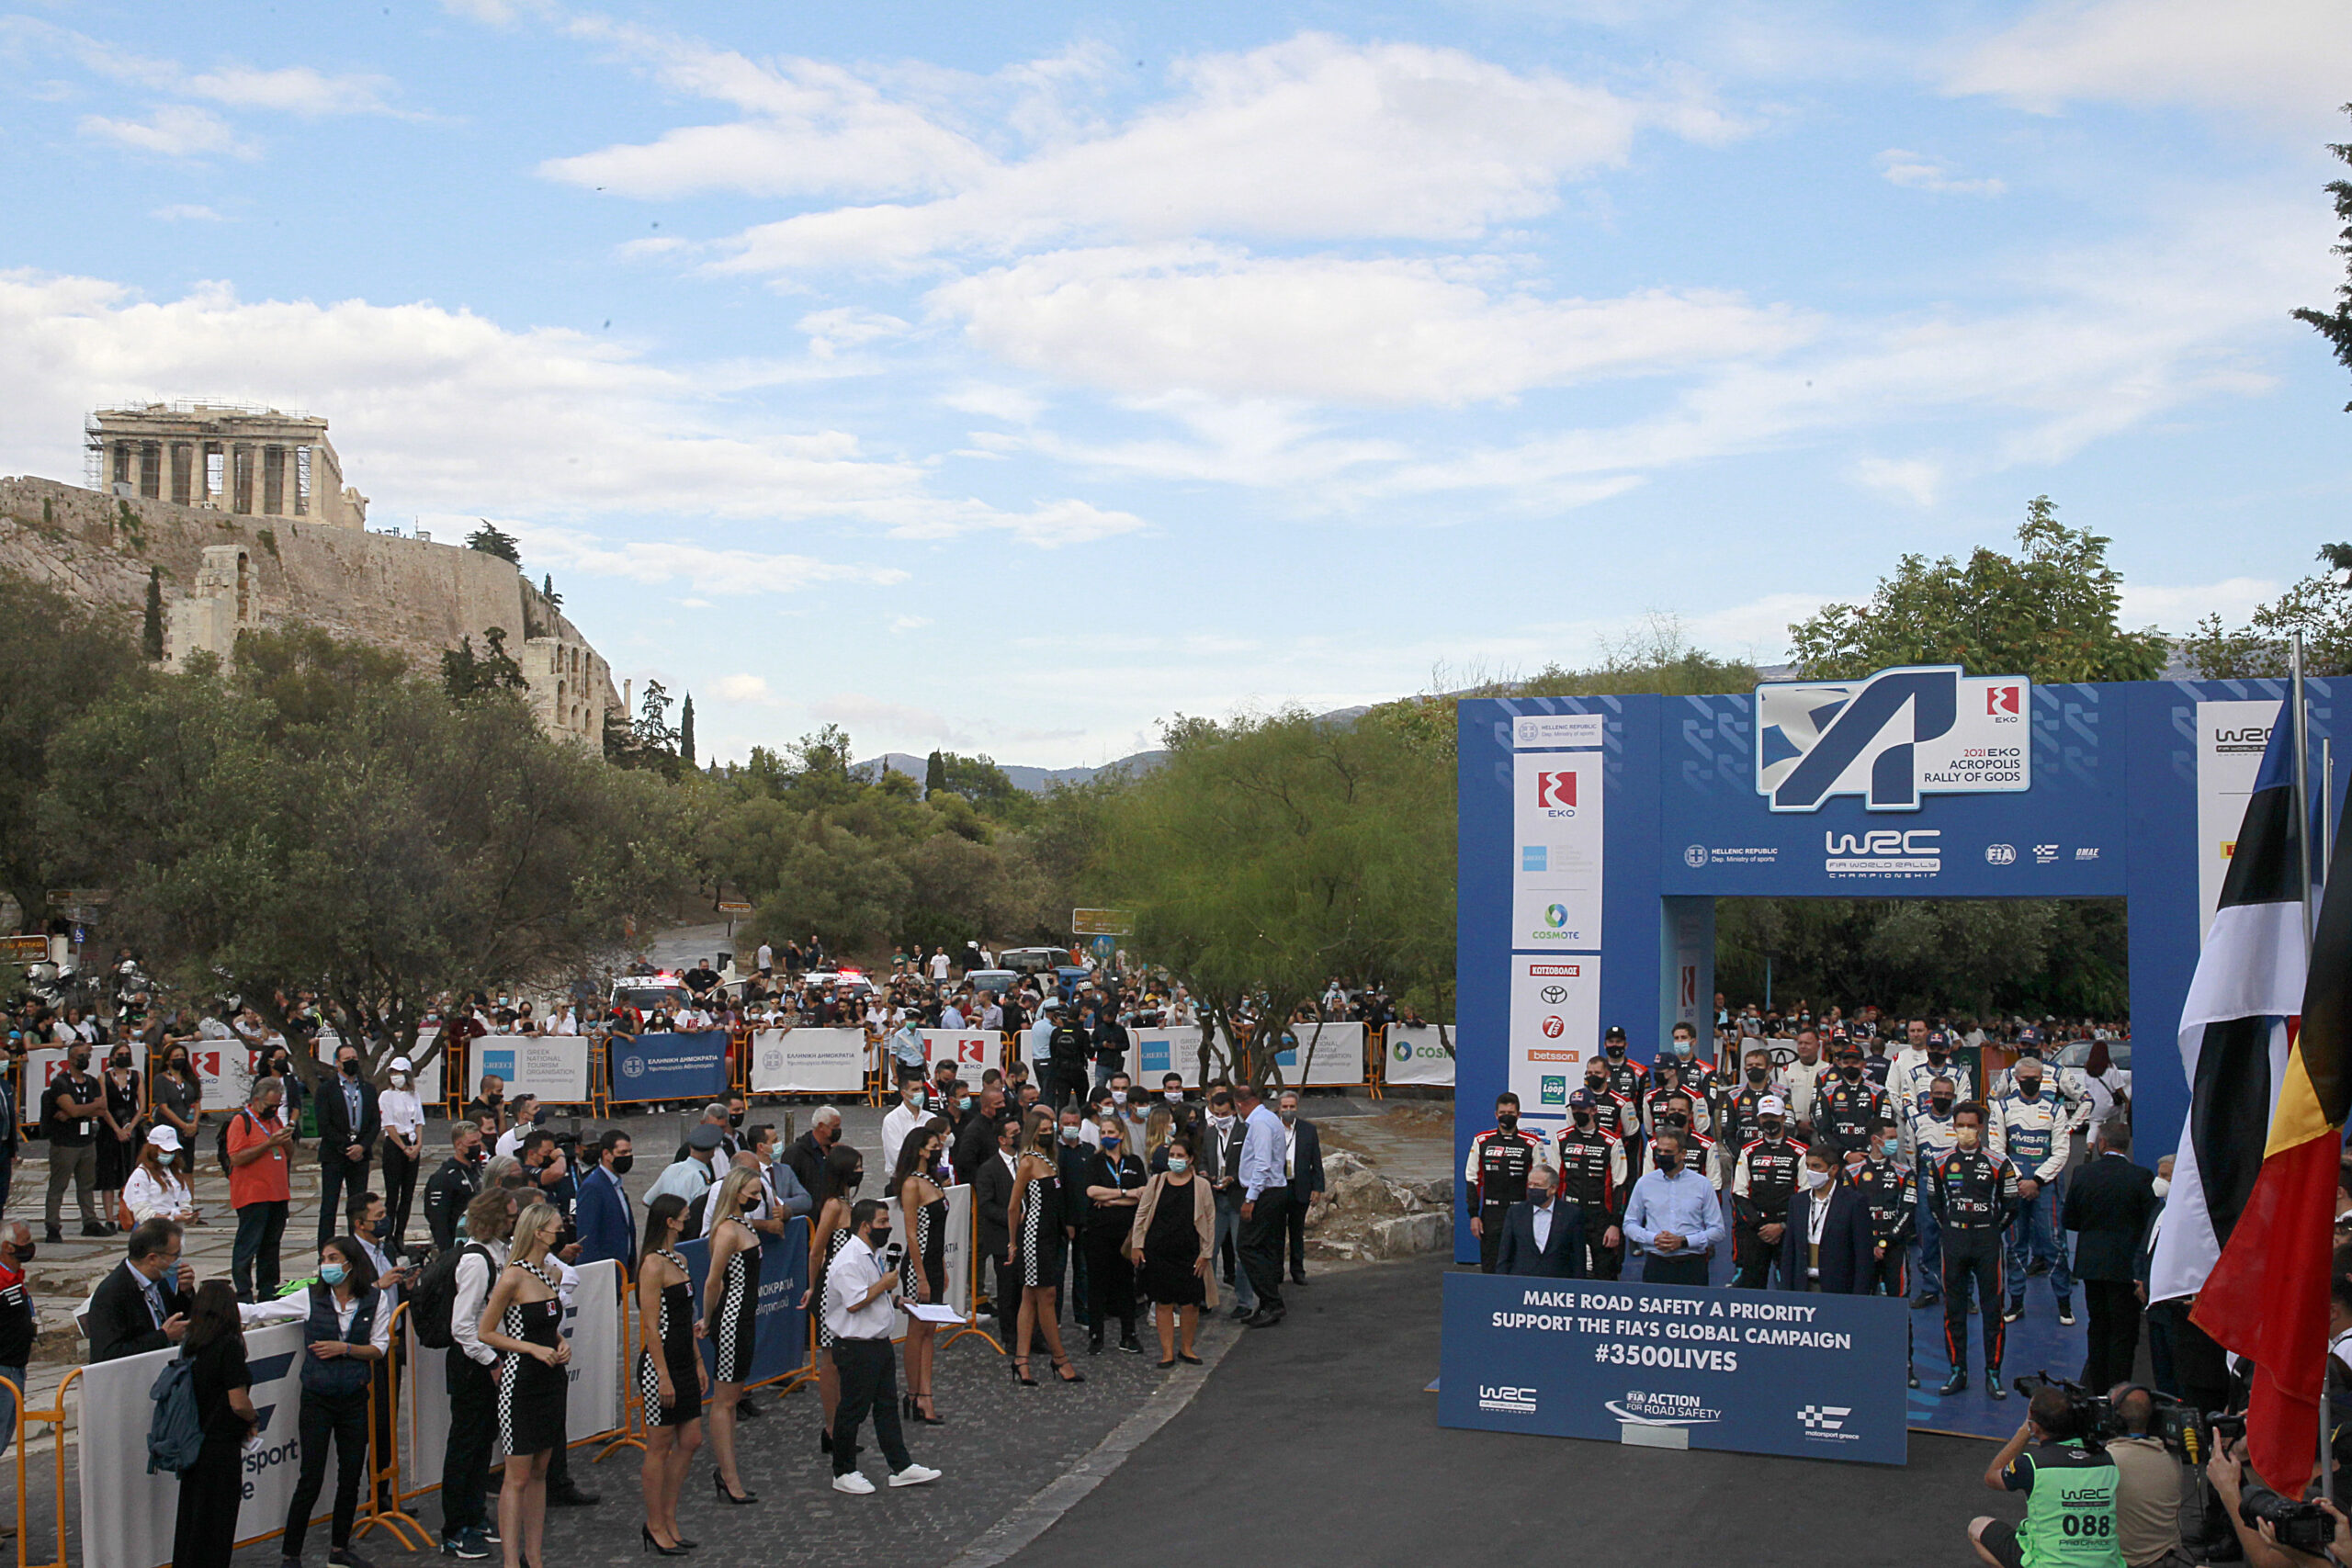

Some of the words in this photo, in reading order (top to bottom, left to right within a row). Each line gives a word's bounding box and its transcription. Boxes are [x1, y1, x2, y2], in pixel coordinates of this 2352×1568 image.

[1964, 749, 1986, 757] 2021
[1987, 748, 2020, 757] EKO
[1950, 759, 2020, 770] ACROPOLIS
[1925, 773, 1961, 782] RALLY
[1964, 773, 1981, 782] OF
[1984, 772, 2020, 782] GODS
[1548, 809, 1576, 818] EKO
[1826, 829, 1941, 854] WRC
[1546, 1018, 1559, 1036] 7
[483, 1061, 514, 1069] GREECE
[680, 1055, 718, 1063] ΔΗΜΟΚΡΑΤΙΑ
[1543, 1084, 1564, 1095] Loop
[1957, 1201, 1988, 1212] MOBIS
[1523, 1291, 1575, 1308] MAKE
[1580, 1295, 1633, 1312] ROAD
[1638, 1298, 1704, 1315] SAFETY
[1709, 1302, 1724, 1317] A
[1729, 1303, 1816, 1323] PRIORITY
[1491, 1312, 1573, 1332] SUPPORT
[1577, 1316, 1610, 1334] THE
[1665, 1323, 1739, 1343] GLOBAL
[1745, 1327, 1850, 1349] CAMPAIGN
[1595, 1344, 1738, 1372] #3500LIVES
[1479, 1384, 1537, 1403] WRC
[1647, 1393, 1700, 1407] ACTION
[1626, 1403, 1643, 1412] FOR
[1644, 1404, 1675, 1416] ROAD
[1677, 1407, 1722, 1419] SAFETY
[1805, 1430, 1838, 1438] motorsport
[2061, 1488, 2109, 1500] WRC
[2062, 1514, 2109, 1537] 088
